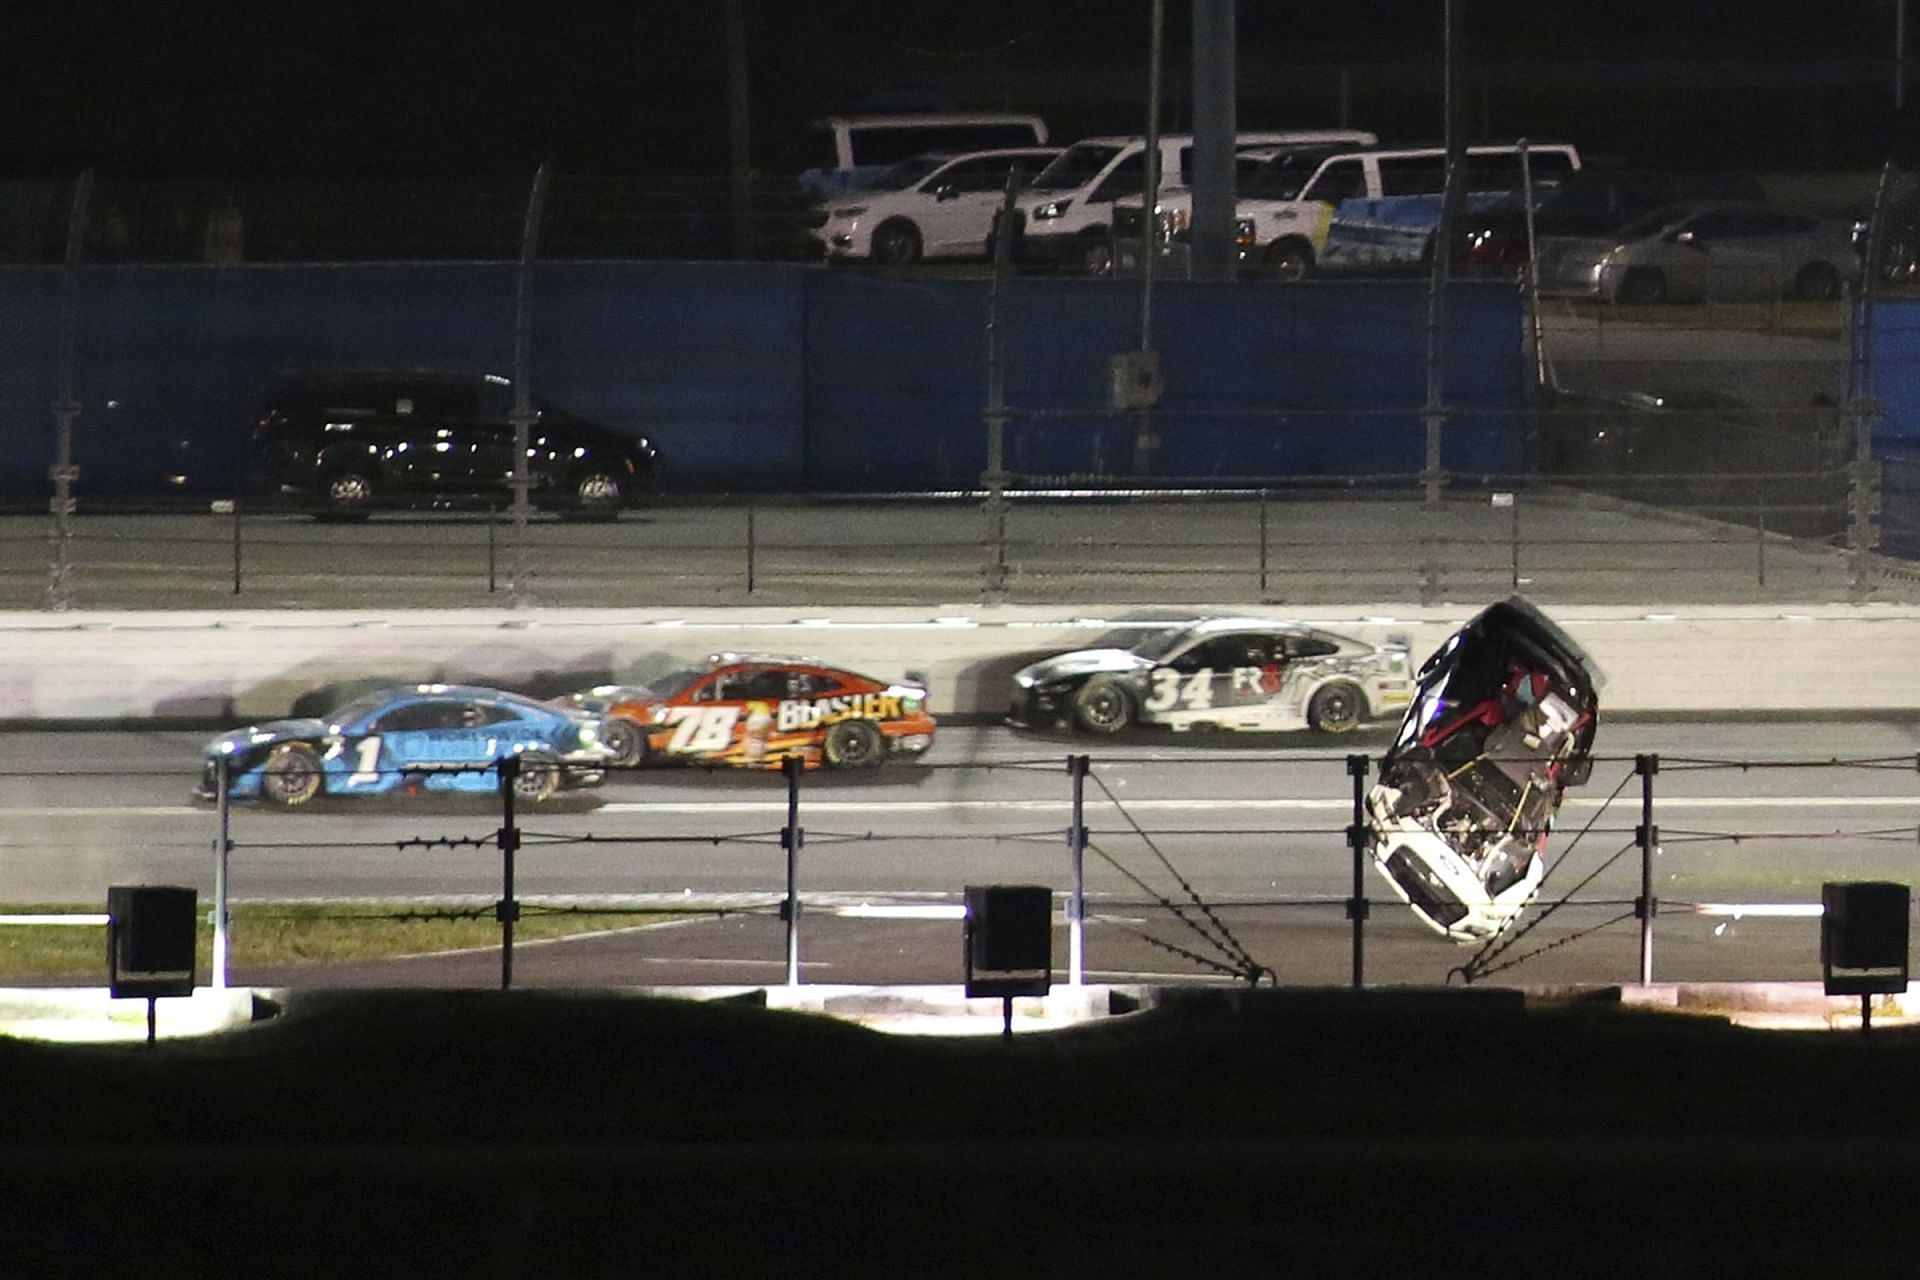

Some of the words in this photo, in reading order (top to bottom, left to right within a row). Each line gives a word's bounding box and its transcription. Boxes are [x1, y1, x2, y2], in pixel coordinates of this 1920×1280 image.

[1144, 667, 1215, 711] 34
[664, 706, 740, 752] 78
[347, 736, 381, 787] 1
